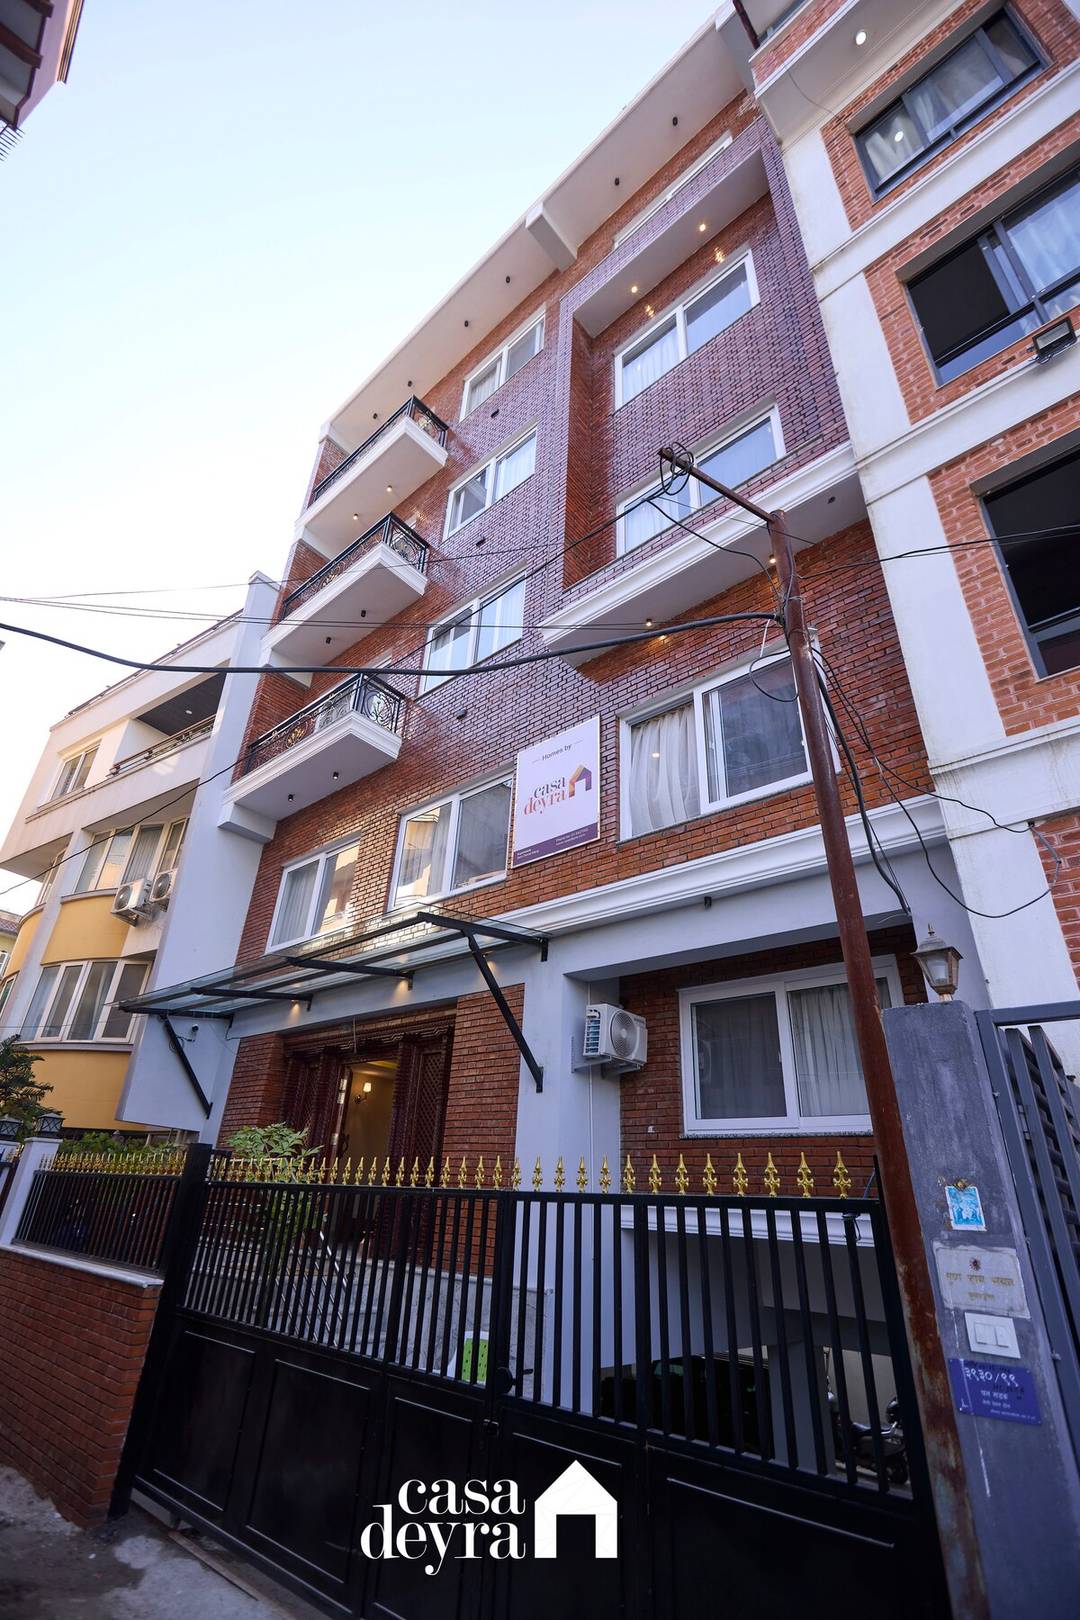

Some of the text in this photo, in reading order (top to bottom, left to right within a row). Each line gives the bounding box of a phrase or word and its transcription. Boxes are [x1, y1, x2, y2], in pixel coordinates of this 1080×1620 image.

[564, 744, 573, 752] by
[533, 777, 566, 799] casa
[523, 790, 566, 815] deyra
